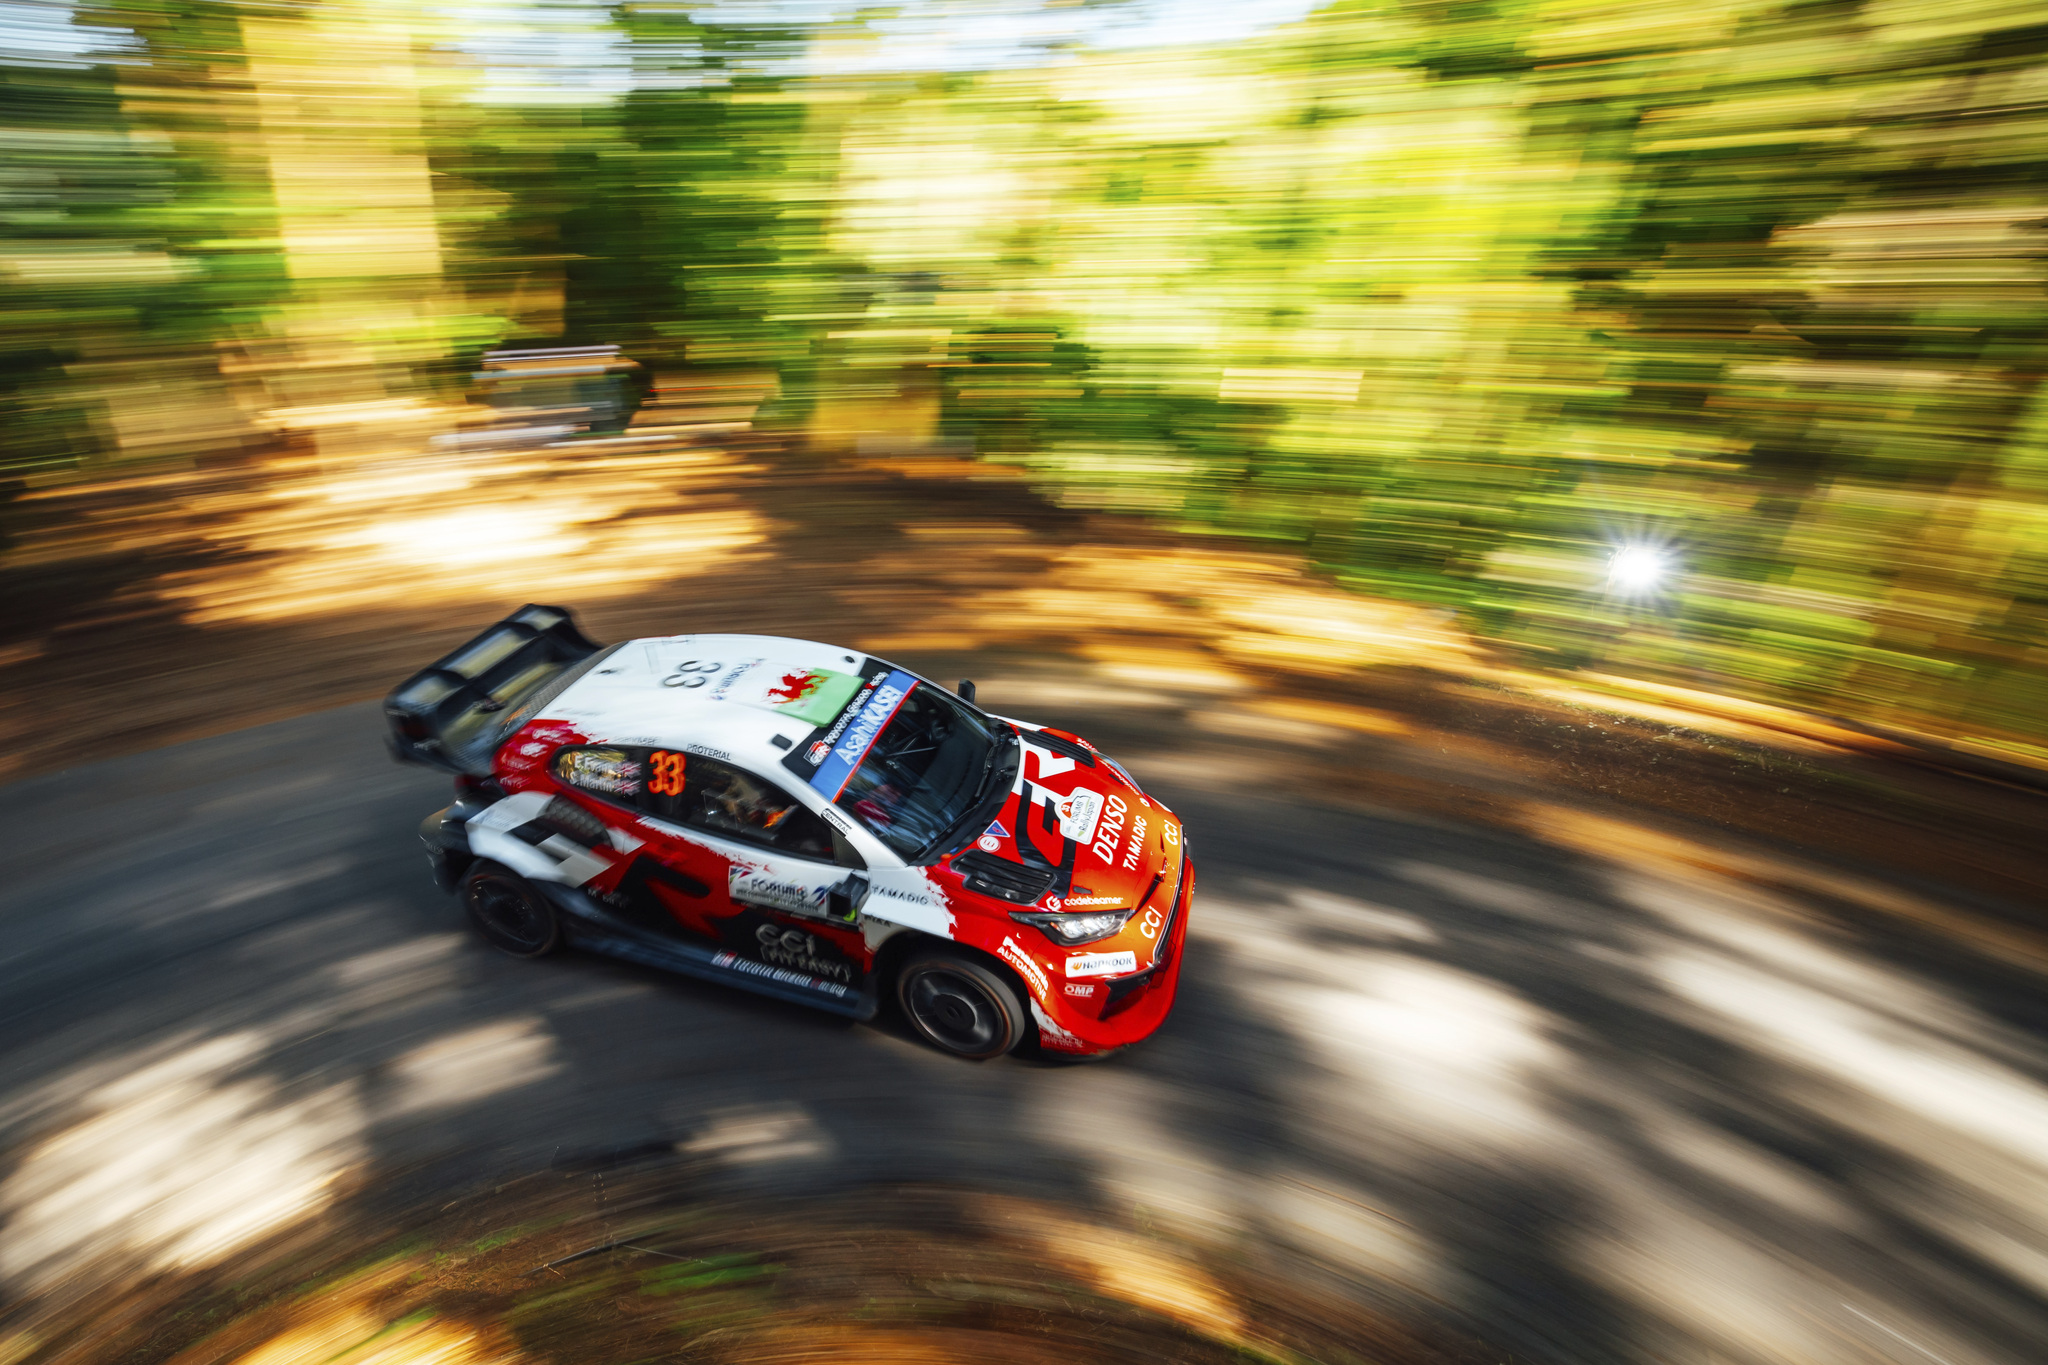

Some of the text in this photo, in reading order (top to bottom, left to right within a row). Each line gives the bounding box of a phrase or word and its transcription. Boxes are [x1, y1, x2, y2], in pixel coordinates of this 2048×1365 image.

[663, 660, 722, 688] 33
[834, 684, 905, 766] AsahiKASEI
[686, 743, 731, 761] PROTERIAL
[648, 750, 687, 797] 33
[821, 809, 849, 835] CENTRAL
[1092, 794, 1128, 866] DENSO
[1163, 819, 1179, 846] CCI
[1122, 815, 1148, 871] TAMADIC
[1063, 895, 1124, 907] codebeamer
[1140, 905, 1164, 939] CCI
[996, 946, 1047, 1002] AUTOMOTIVE
[1063, 984, 1095, 996] OMP
